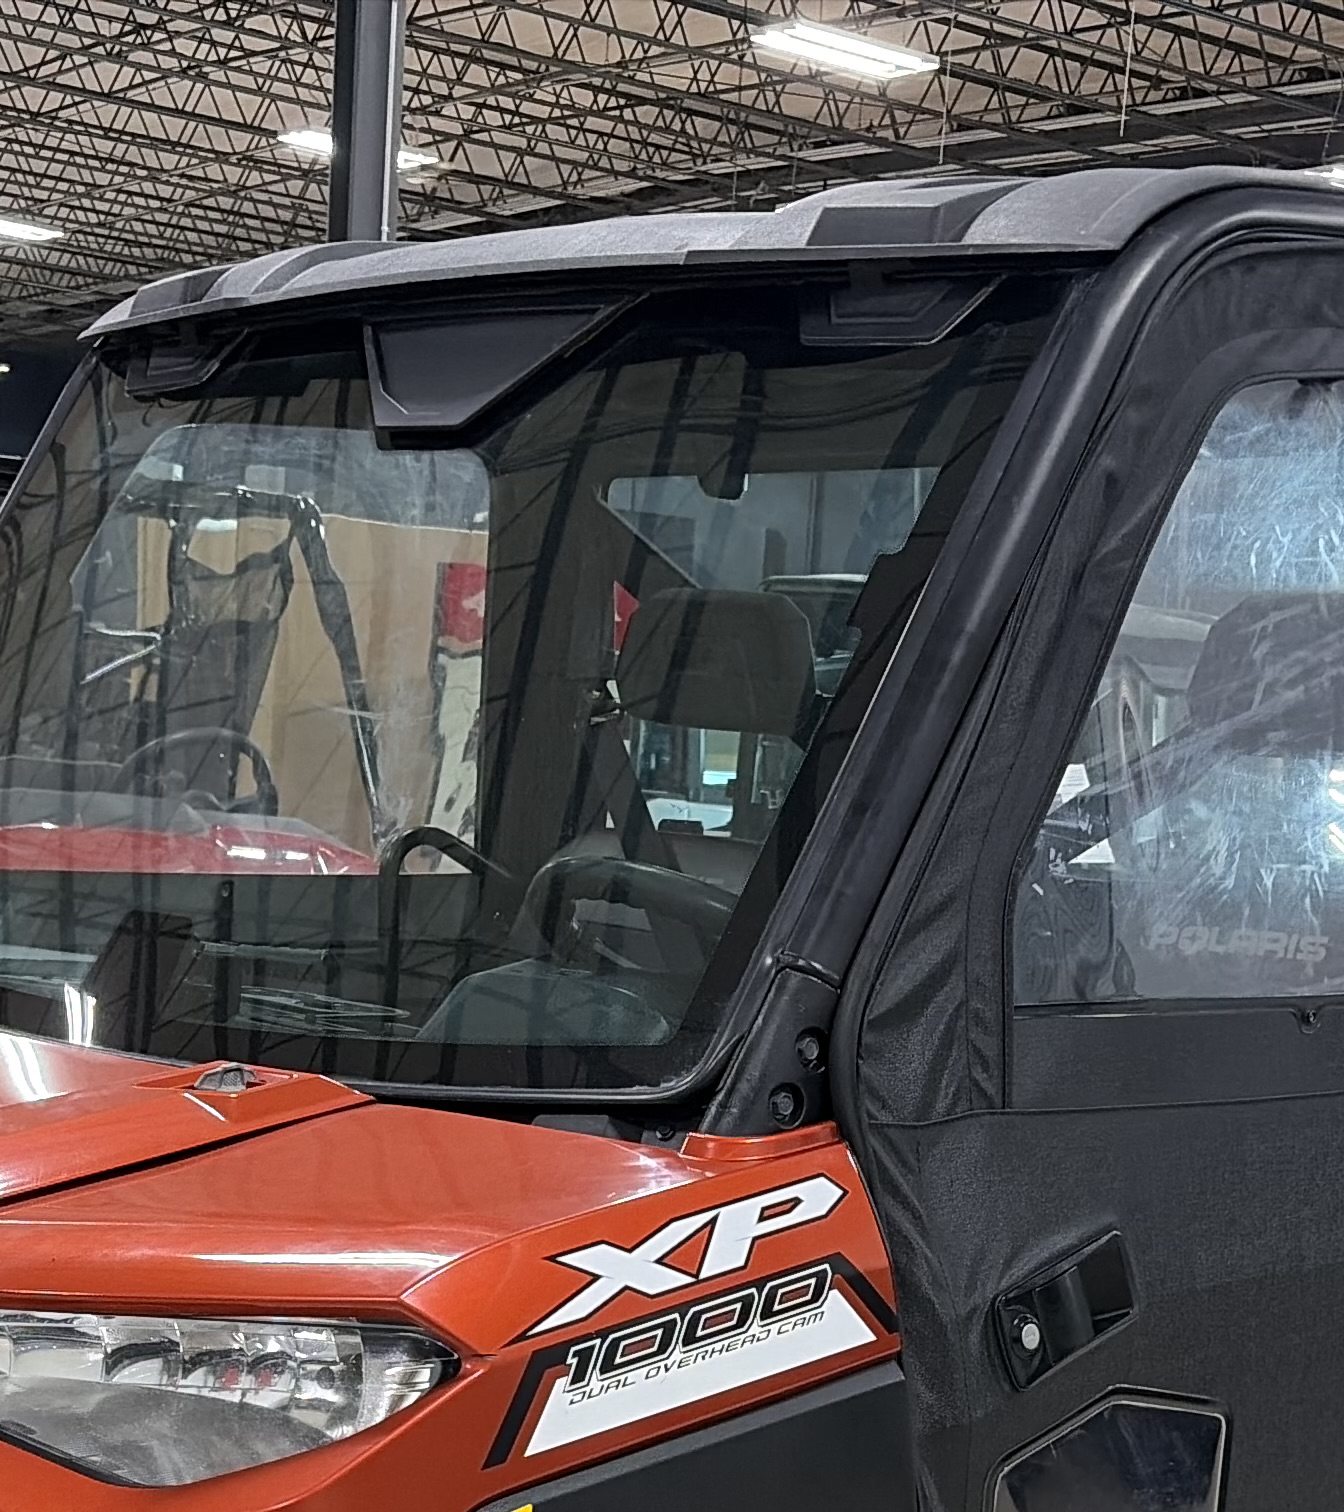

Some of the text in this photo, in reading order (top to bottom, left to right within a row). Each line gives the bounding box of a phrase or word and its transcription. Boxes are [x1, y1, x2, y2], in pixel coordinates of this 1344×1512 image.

[1148, 925, 1329, 963] POLARIS
[506, 1173, 848, 1345] XP
[563, 1262, 833, 1393] 1000
[568, 1310, 826, 1406] DUAL OVERHEAD CAM
